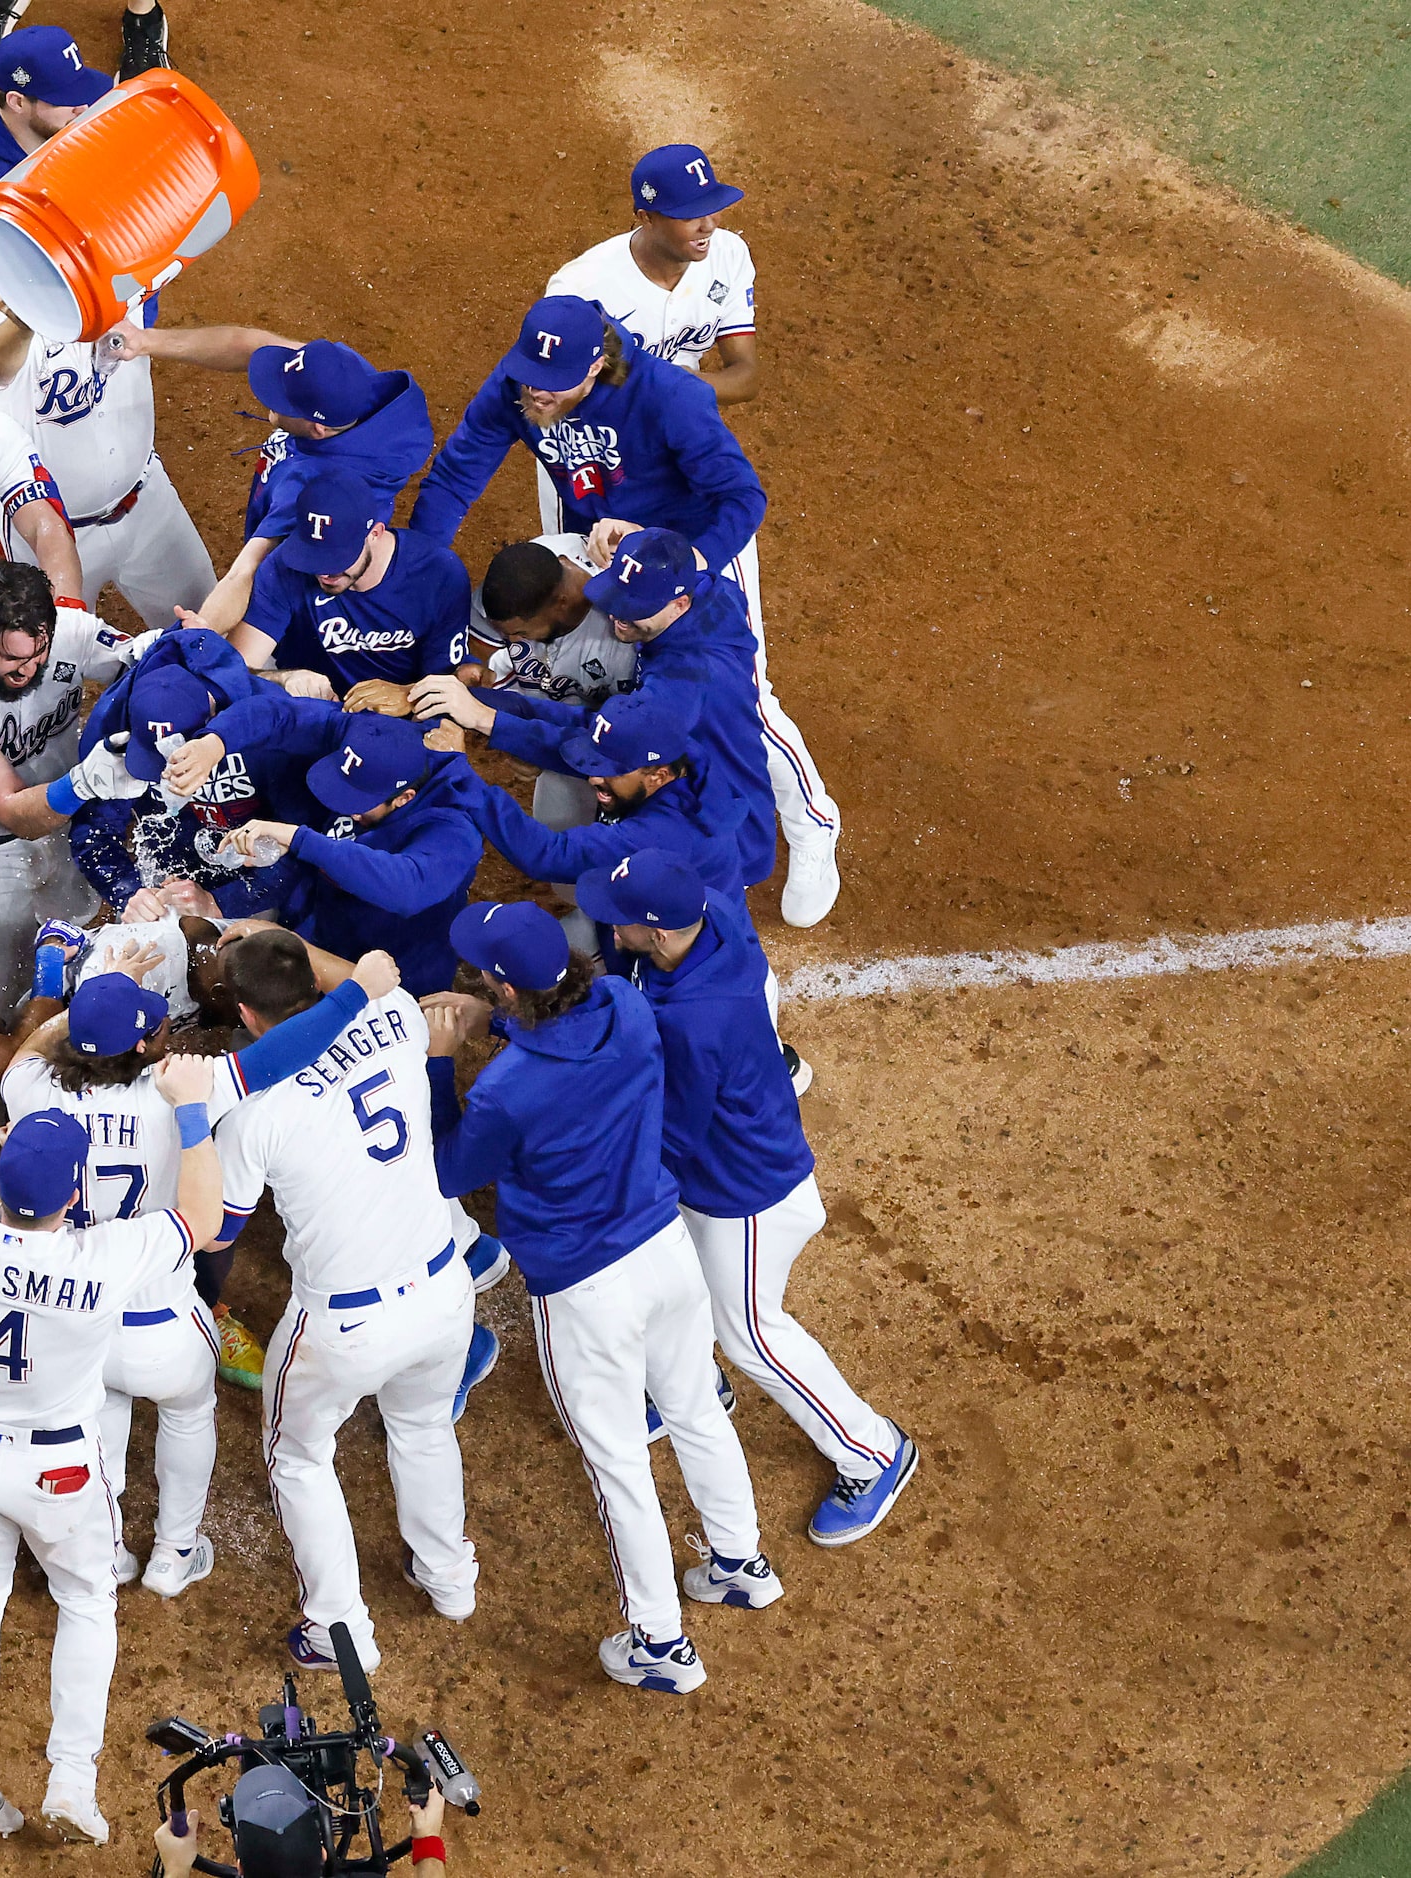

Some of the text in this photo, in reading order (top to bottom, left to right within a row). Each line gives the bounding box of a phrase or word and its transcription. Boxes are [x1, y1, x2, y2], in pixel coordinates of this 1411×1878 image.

[62, 42, 84, 71] T
[685, 158, 709, 186] T
[536, 330, 562, 359] T
[572, 466, 596, 491] T
[308, 512, 332, 541] T
[618, 554, 643, 584] T
[147, 721, 173, 743] T
[592, 714, 612, 744] T
[340, 746, 363, 776] T
[295, 1008, 411, 1100] SEAGER
[84, 1113, 140, 1148] ITH
[347, 1067, 411, 1167] 5
[434, 1741, 460, 1775] essentia
